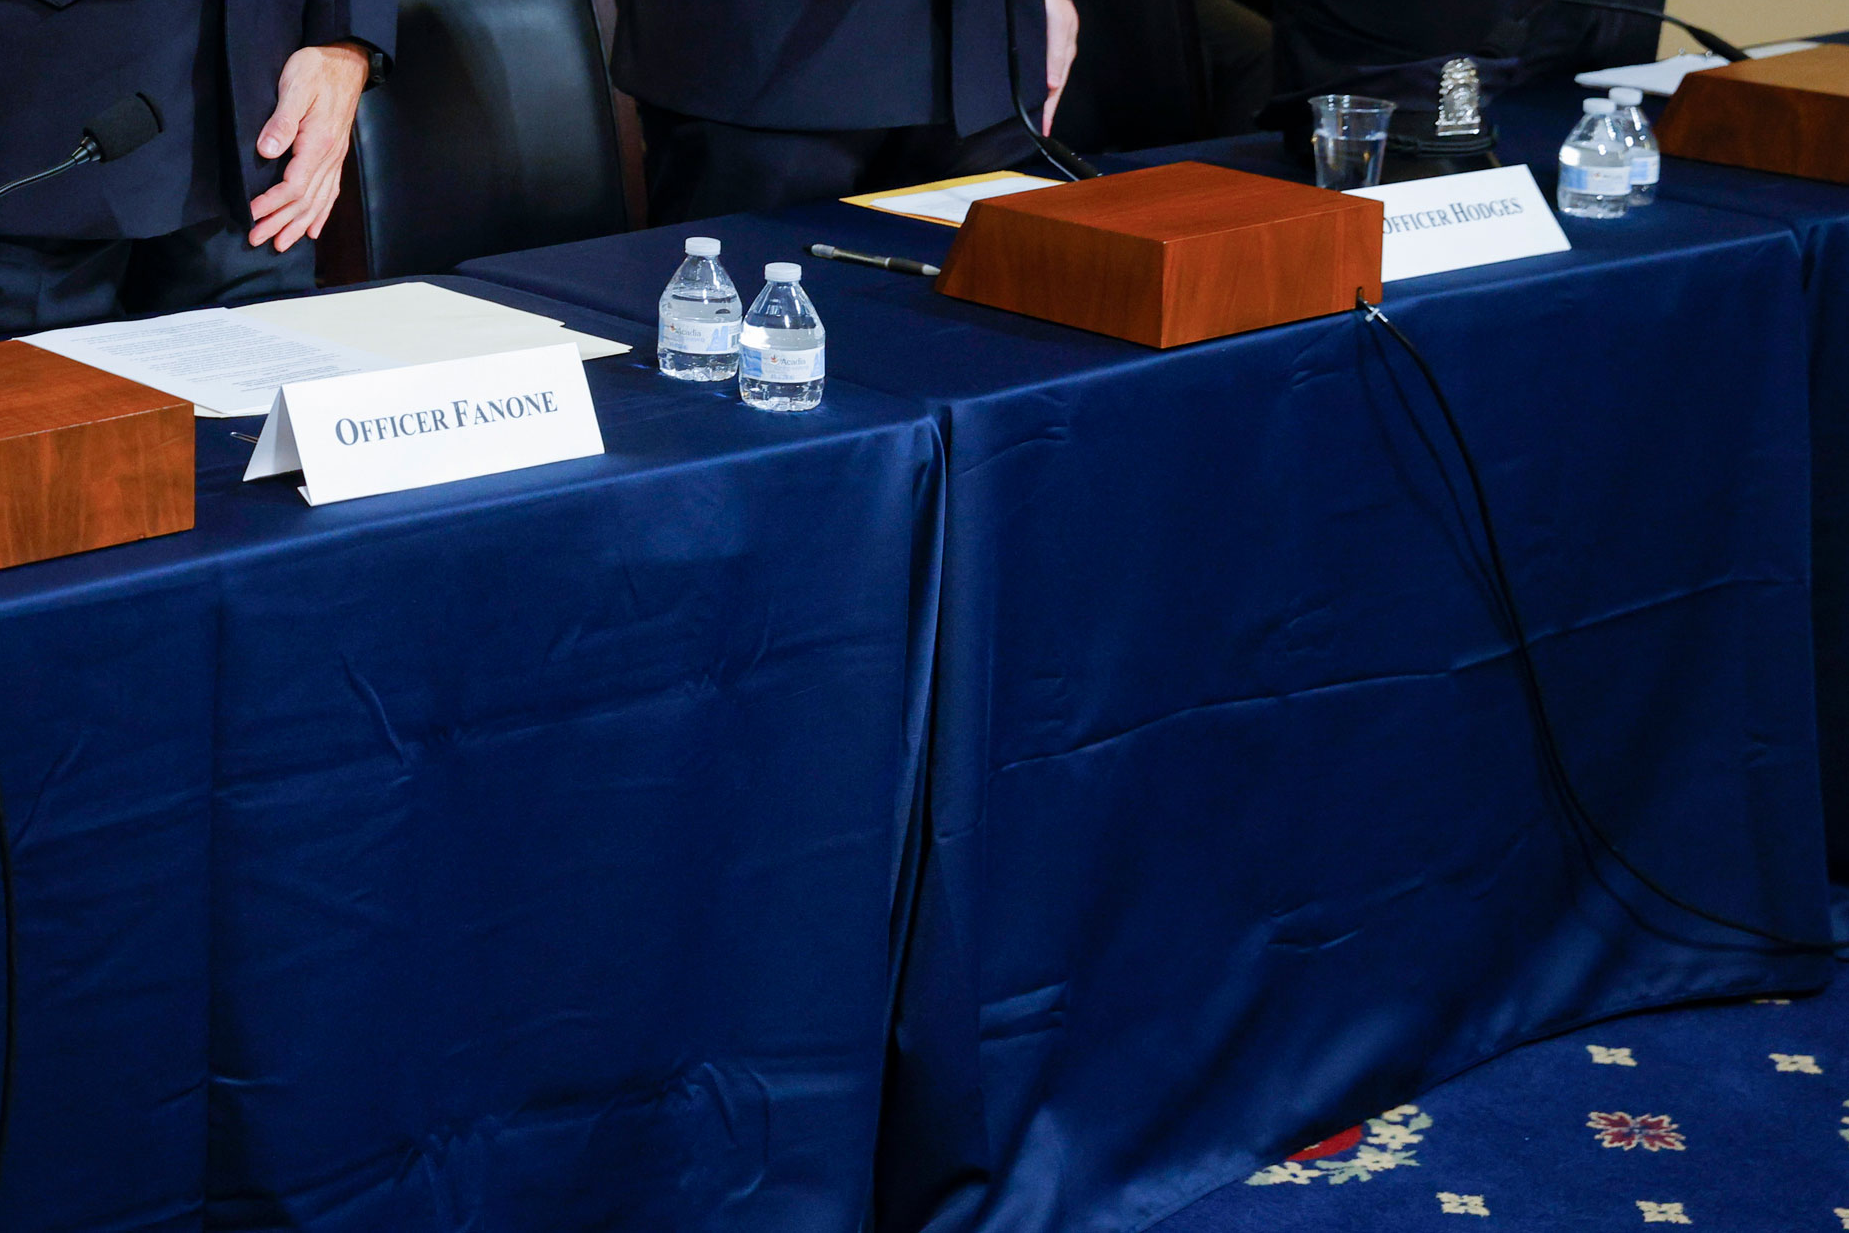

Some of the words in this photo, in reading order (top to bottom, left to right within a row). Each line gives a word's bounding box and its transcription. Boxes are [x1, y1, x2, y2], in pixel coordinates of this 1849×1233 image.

[1449, 197, 1524, 223] HODGES
[335, 408, 450, 446] OFFICER
[451, 391, 558, 427] FANONE
